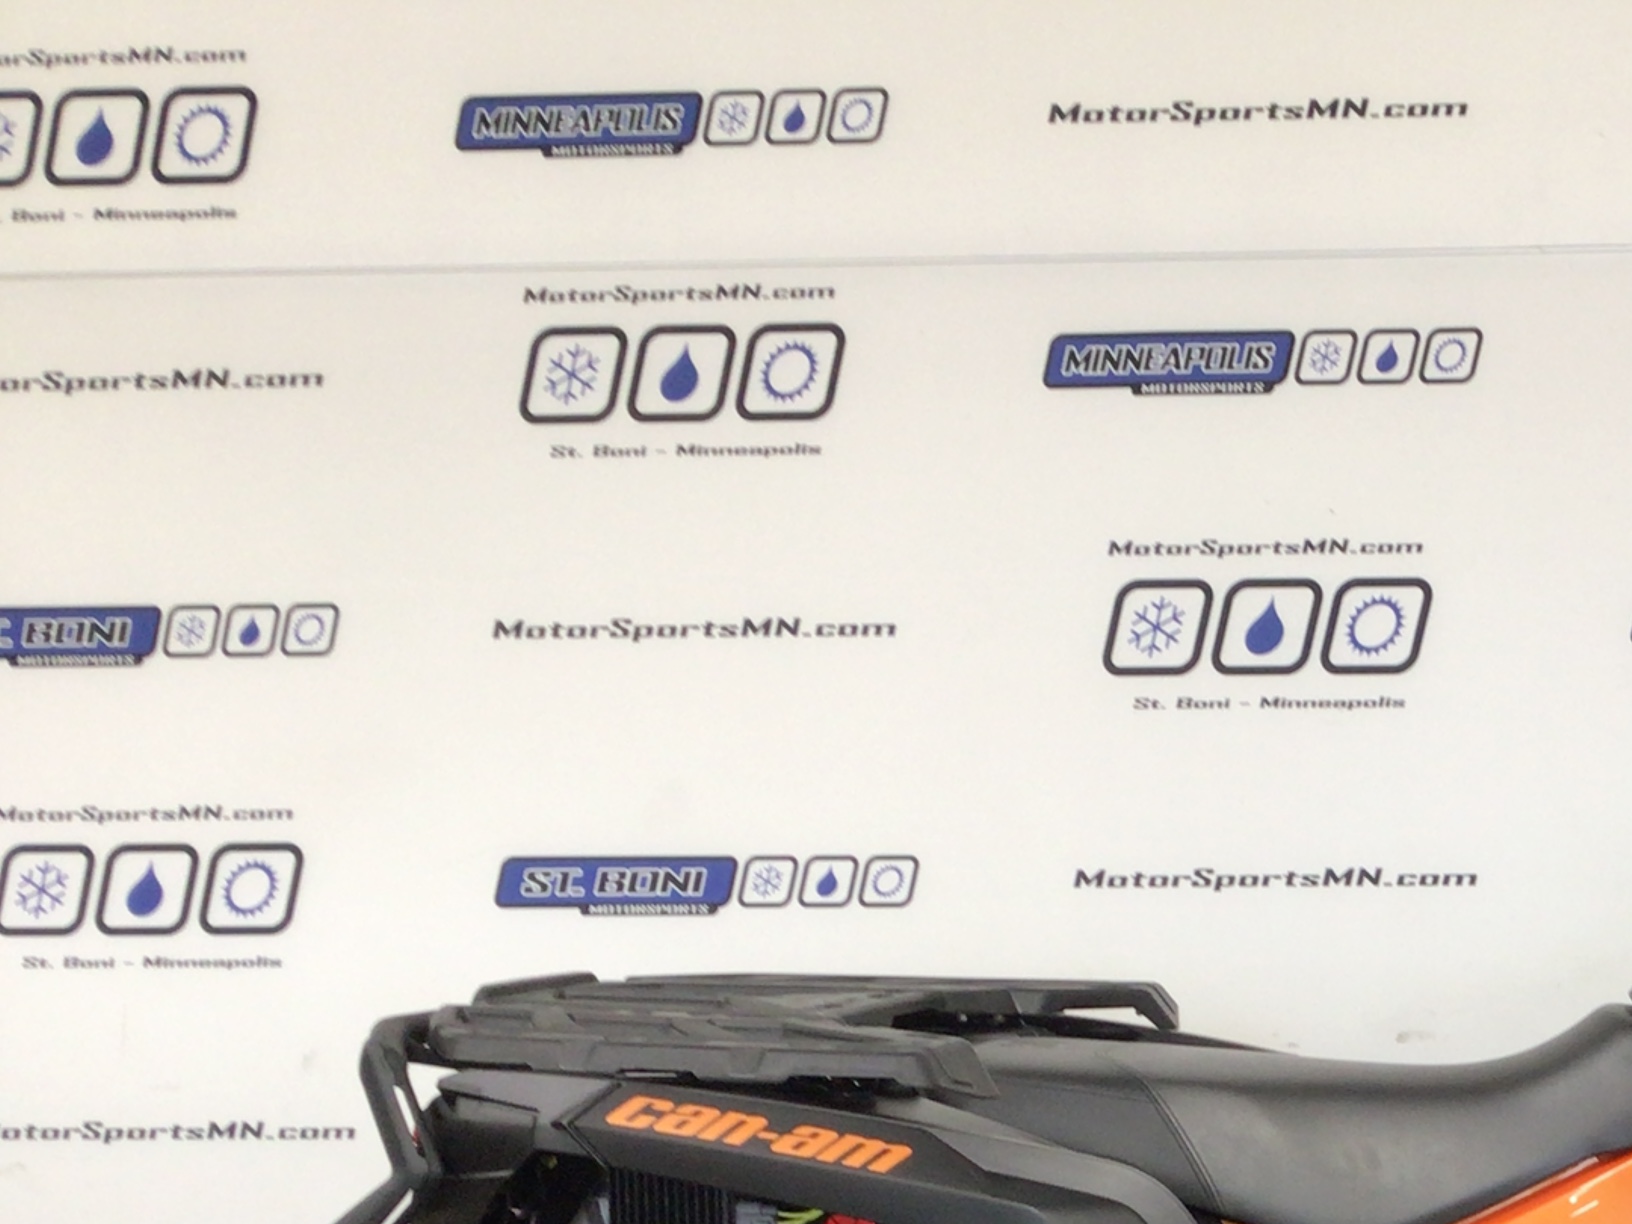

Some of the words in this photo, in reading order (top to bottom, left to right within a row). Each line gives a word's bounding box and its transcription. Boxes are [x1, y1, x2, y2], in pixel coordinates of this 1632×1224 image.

[0, 45, 247, 70] orSportsMN.com
[472, 103, 684, 139] MINNEAPOLIS
[1047, 97, 1469, 127] MotorSportsMN.com
[92, 205, 238, 223] Minneapolis
[522, 282, 836, 306] MotorSportsMN.com
[1061, 342, 1275, 377] MINNEAPOLIS
[0, 367, 325, 397] orSportsMN.com
[549, 444, 583, 459] St.
[592, 443, 648, 459] Boni
[675, 442, 823, 459] Minneapolis
[1107, 537, 1424, 560] MotorSportsMN.com
[21, 617, 133, 648] BONI
[492, 616, 897, 644] MotorSportsMN.com
[1132, 697, 1166, 711] St.
[1175, 696, 1231, 710] Boni
[1259, 695, 1406, 711] Minneapolis
[520, 867, 586, 898] ST.
[593, 866, 708, 898] BONI
[1073, 867, 1478, 893] MotorSportsMN.com
[21, 955, 54, 970] St.
[62, 955, 116, 970] Boni
[141, 954, 283, 971] Minneapolis
[0, 1120, 356, 1145] otorSportsMN.com
